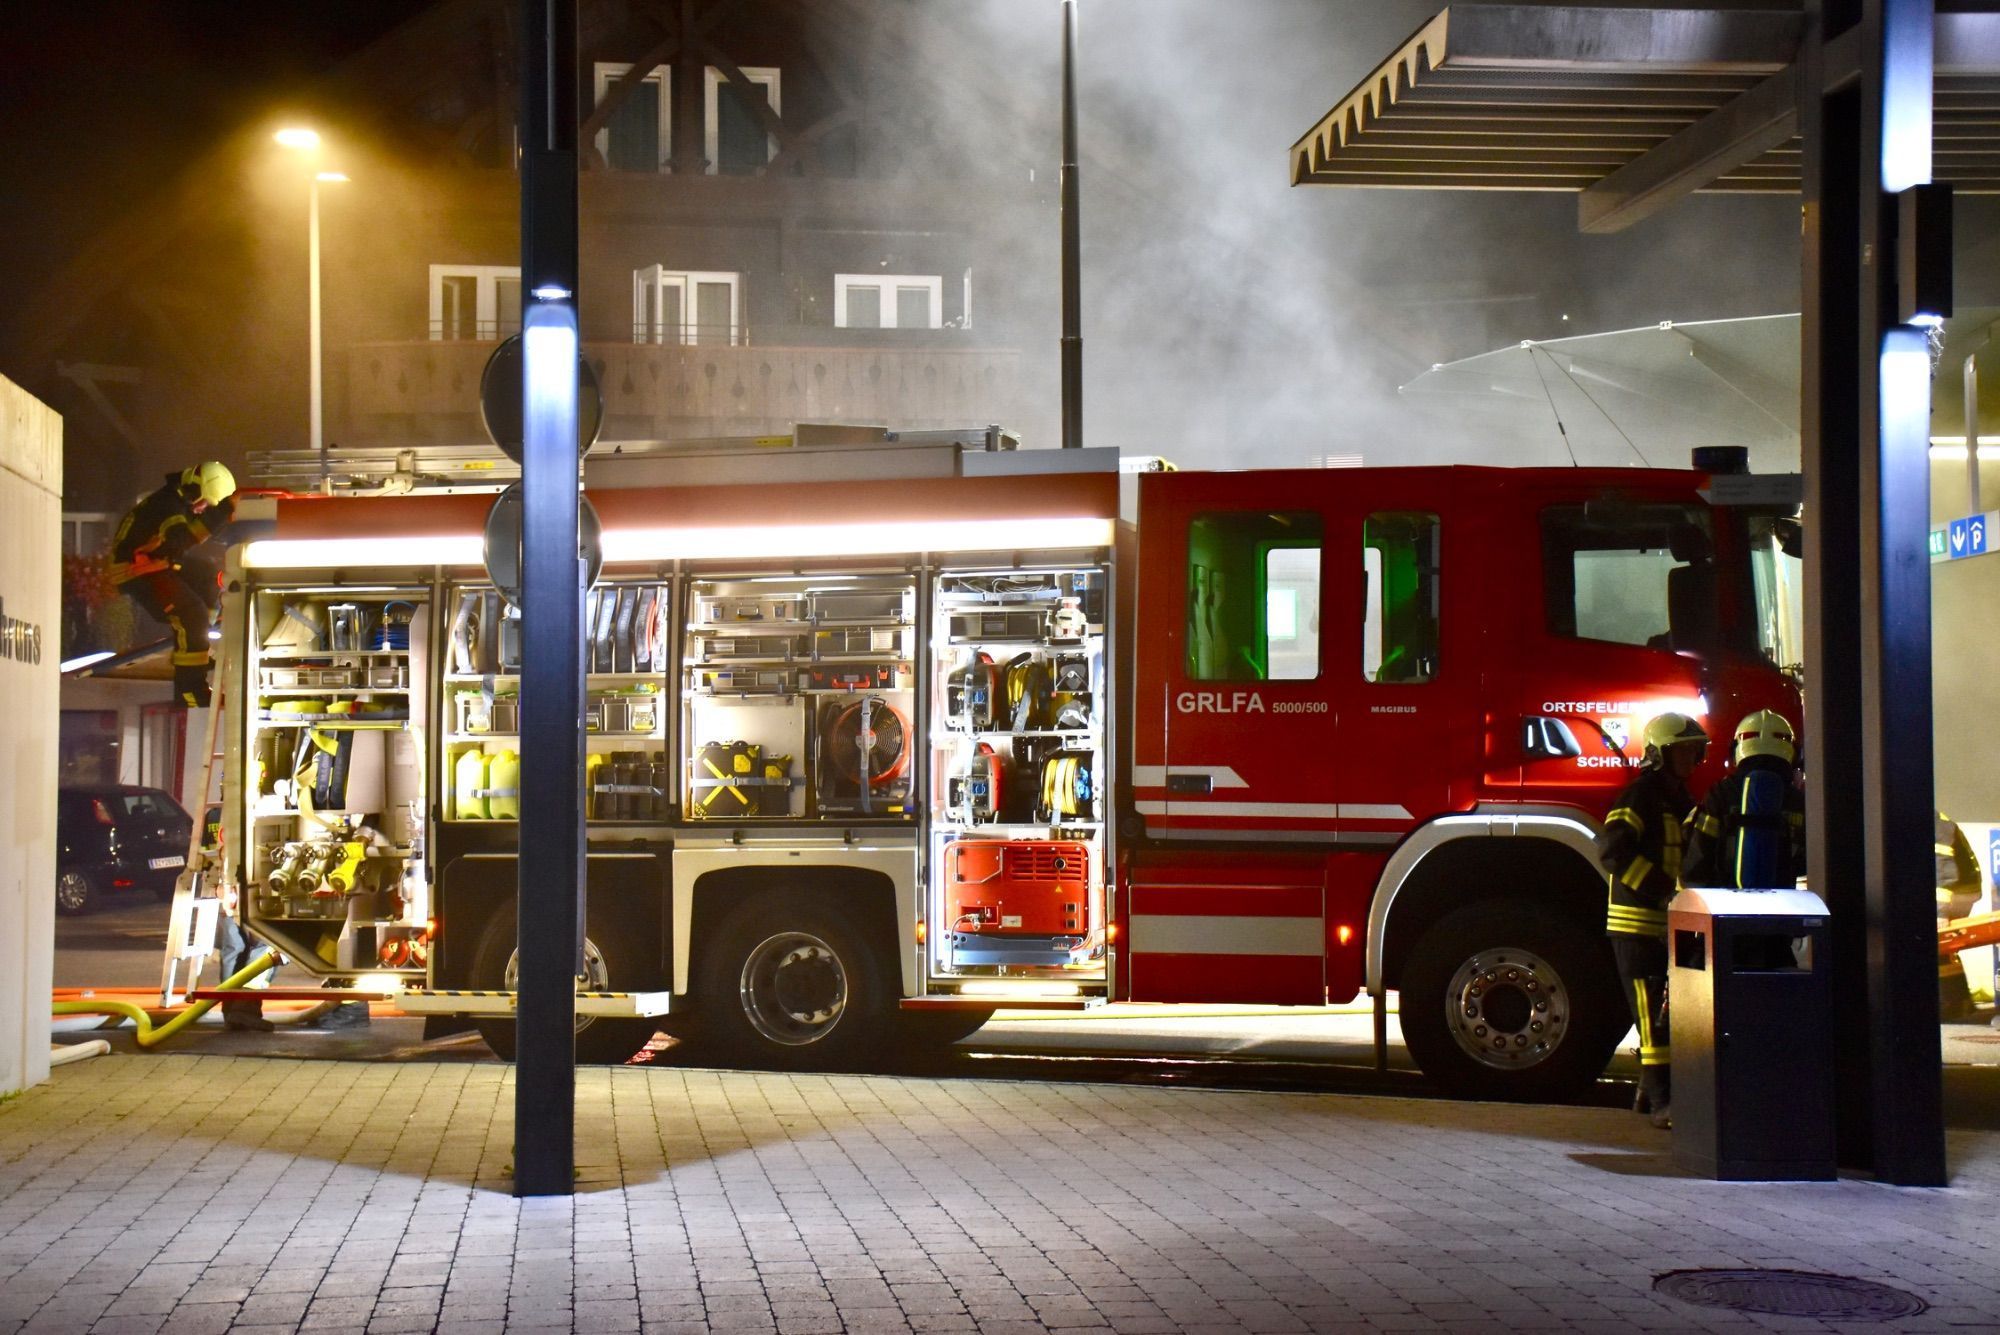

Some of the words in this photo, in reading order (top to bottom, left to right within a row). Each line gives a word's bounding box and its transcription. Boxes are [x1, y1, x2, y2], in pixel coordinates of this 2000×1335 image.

[1973, 531, 1982, 550] P
[1176, 692, 1265, 713] GRLFA
[1272, 702, 1328, 713] 5000/500
[1371, 706, 1417, 714] MAGIRUS
[1542, 702, 1633, 714] ORTSFEUE
